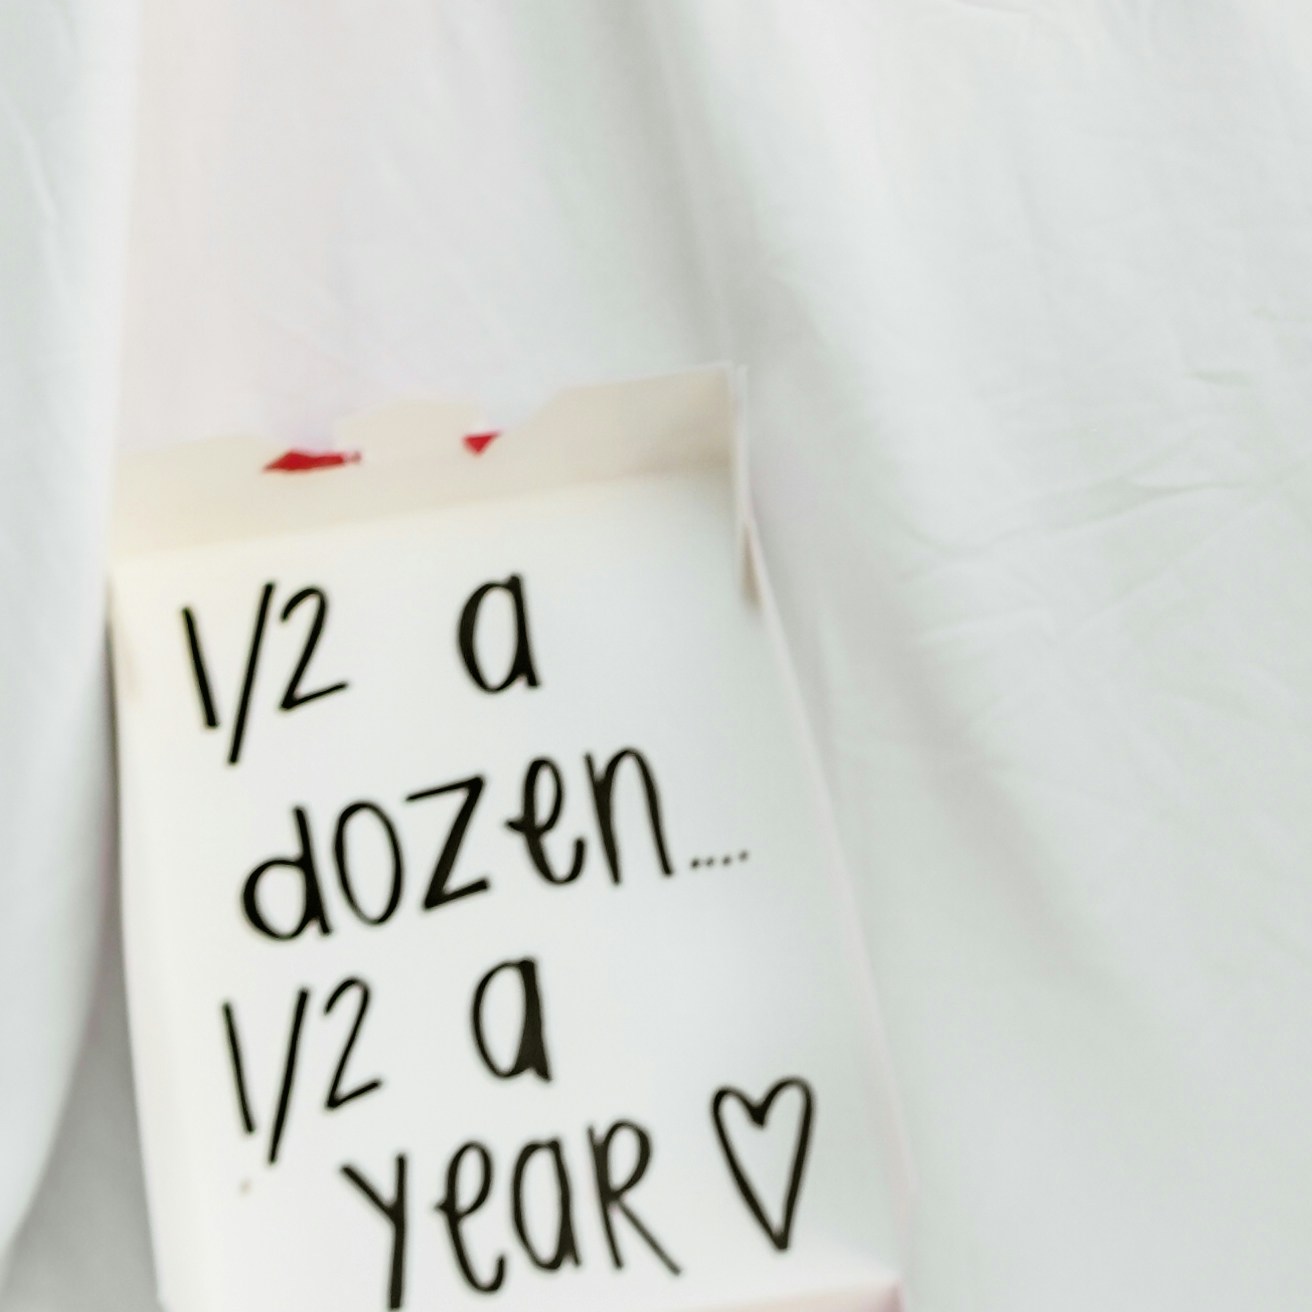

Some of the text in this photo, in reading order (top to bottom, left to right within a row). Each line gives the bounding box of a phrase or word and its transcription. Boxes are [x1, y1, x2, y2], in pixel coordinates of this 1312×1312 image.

[180, 573, 541, 766] 1/2 a
[223, 956, 553, 1164] 1/2 a
